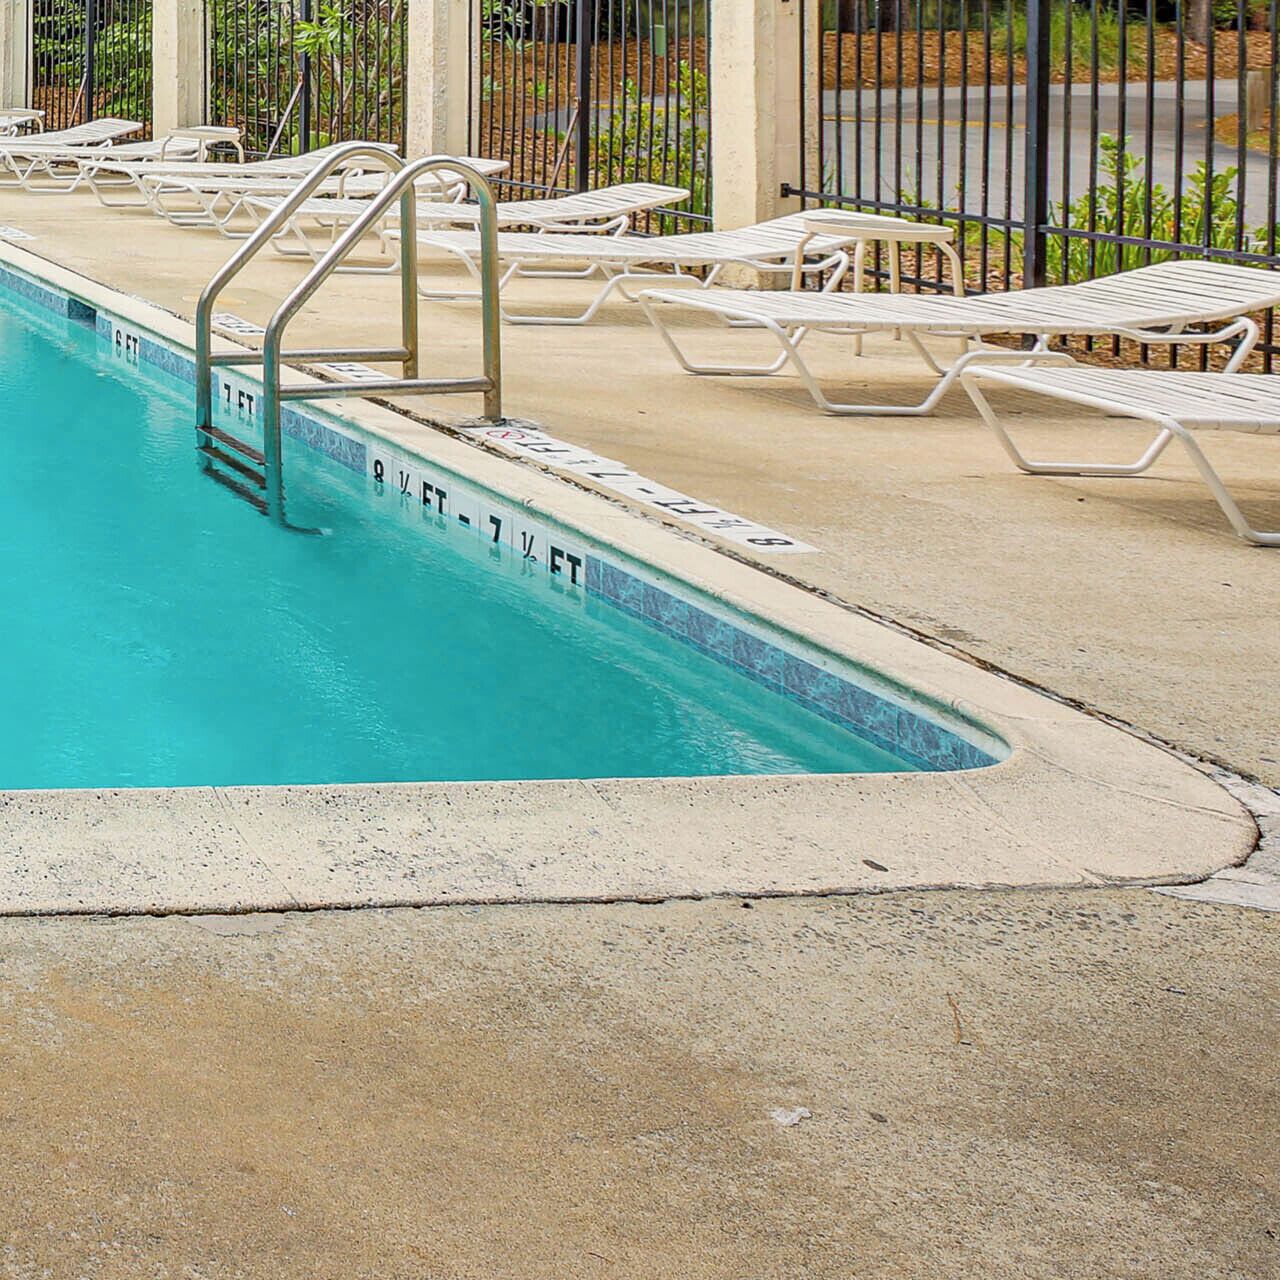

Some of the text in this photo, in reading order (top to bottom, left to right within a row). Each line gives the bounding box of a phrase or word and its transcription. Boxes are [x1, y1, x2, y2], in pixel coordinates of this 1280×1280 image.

[126, 334, 138, 355] FT
[224, 383, 254, 415] 7 FT
[654, 499, 718, 515] FT
[373, 459, 384, 483] 8
[422, 480, 448, 515] FT
[489, 514, 502, 543] 7
[550, 545, 582, 585] FT
[745, 537, 795, 547] 8
